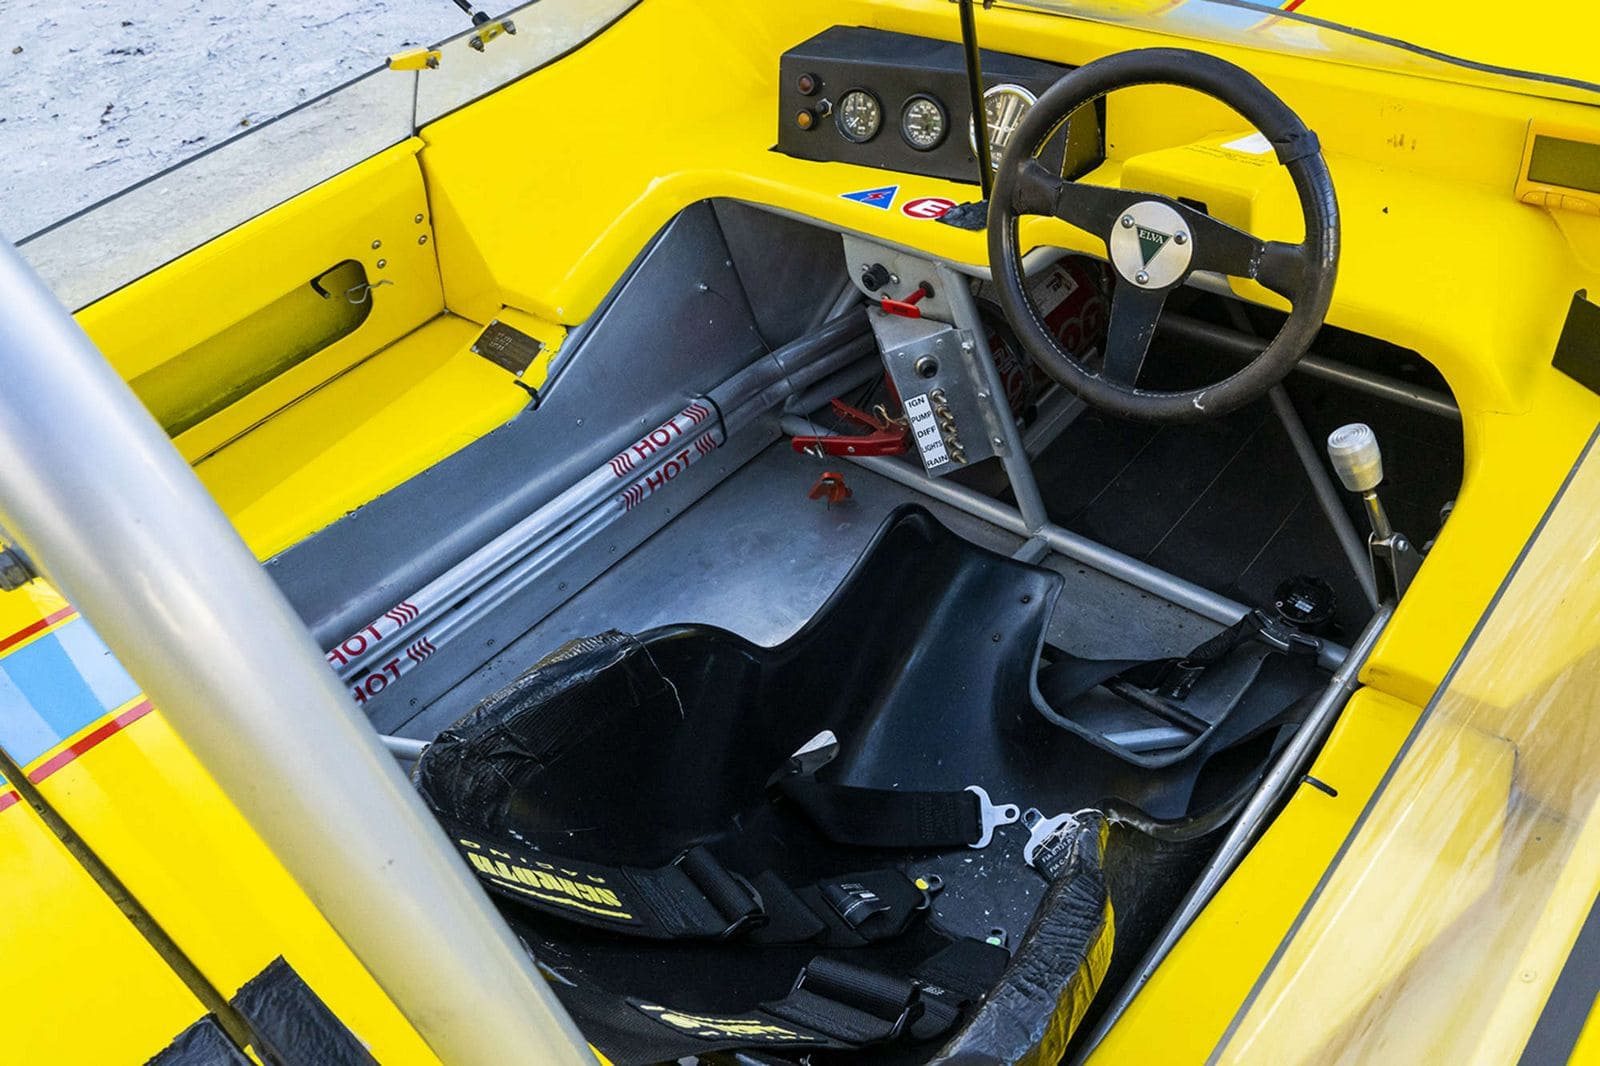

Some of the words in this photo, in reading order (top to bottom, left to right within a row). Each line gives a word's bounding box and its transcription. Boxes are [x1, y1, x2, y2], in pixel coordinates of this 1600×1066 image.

[908, 200, 951, 217] E
[1139, 229, 1164, 244] ELVA
[908, 397, 925, 408] IGN
[911, 410, 932, 423] PUMP
[917, 425, 936, 438] DIFF
[632, 418, 682, 460] HOT
[922, 440, 943, 453] LIGHTS
[926, 455, 948, 467] RAIN
[645, 449, 690, 493] HOT
[467, 851, 623, 907] SCHROTH
